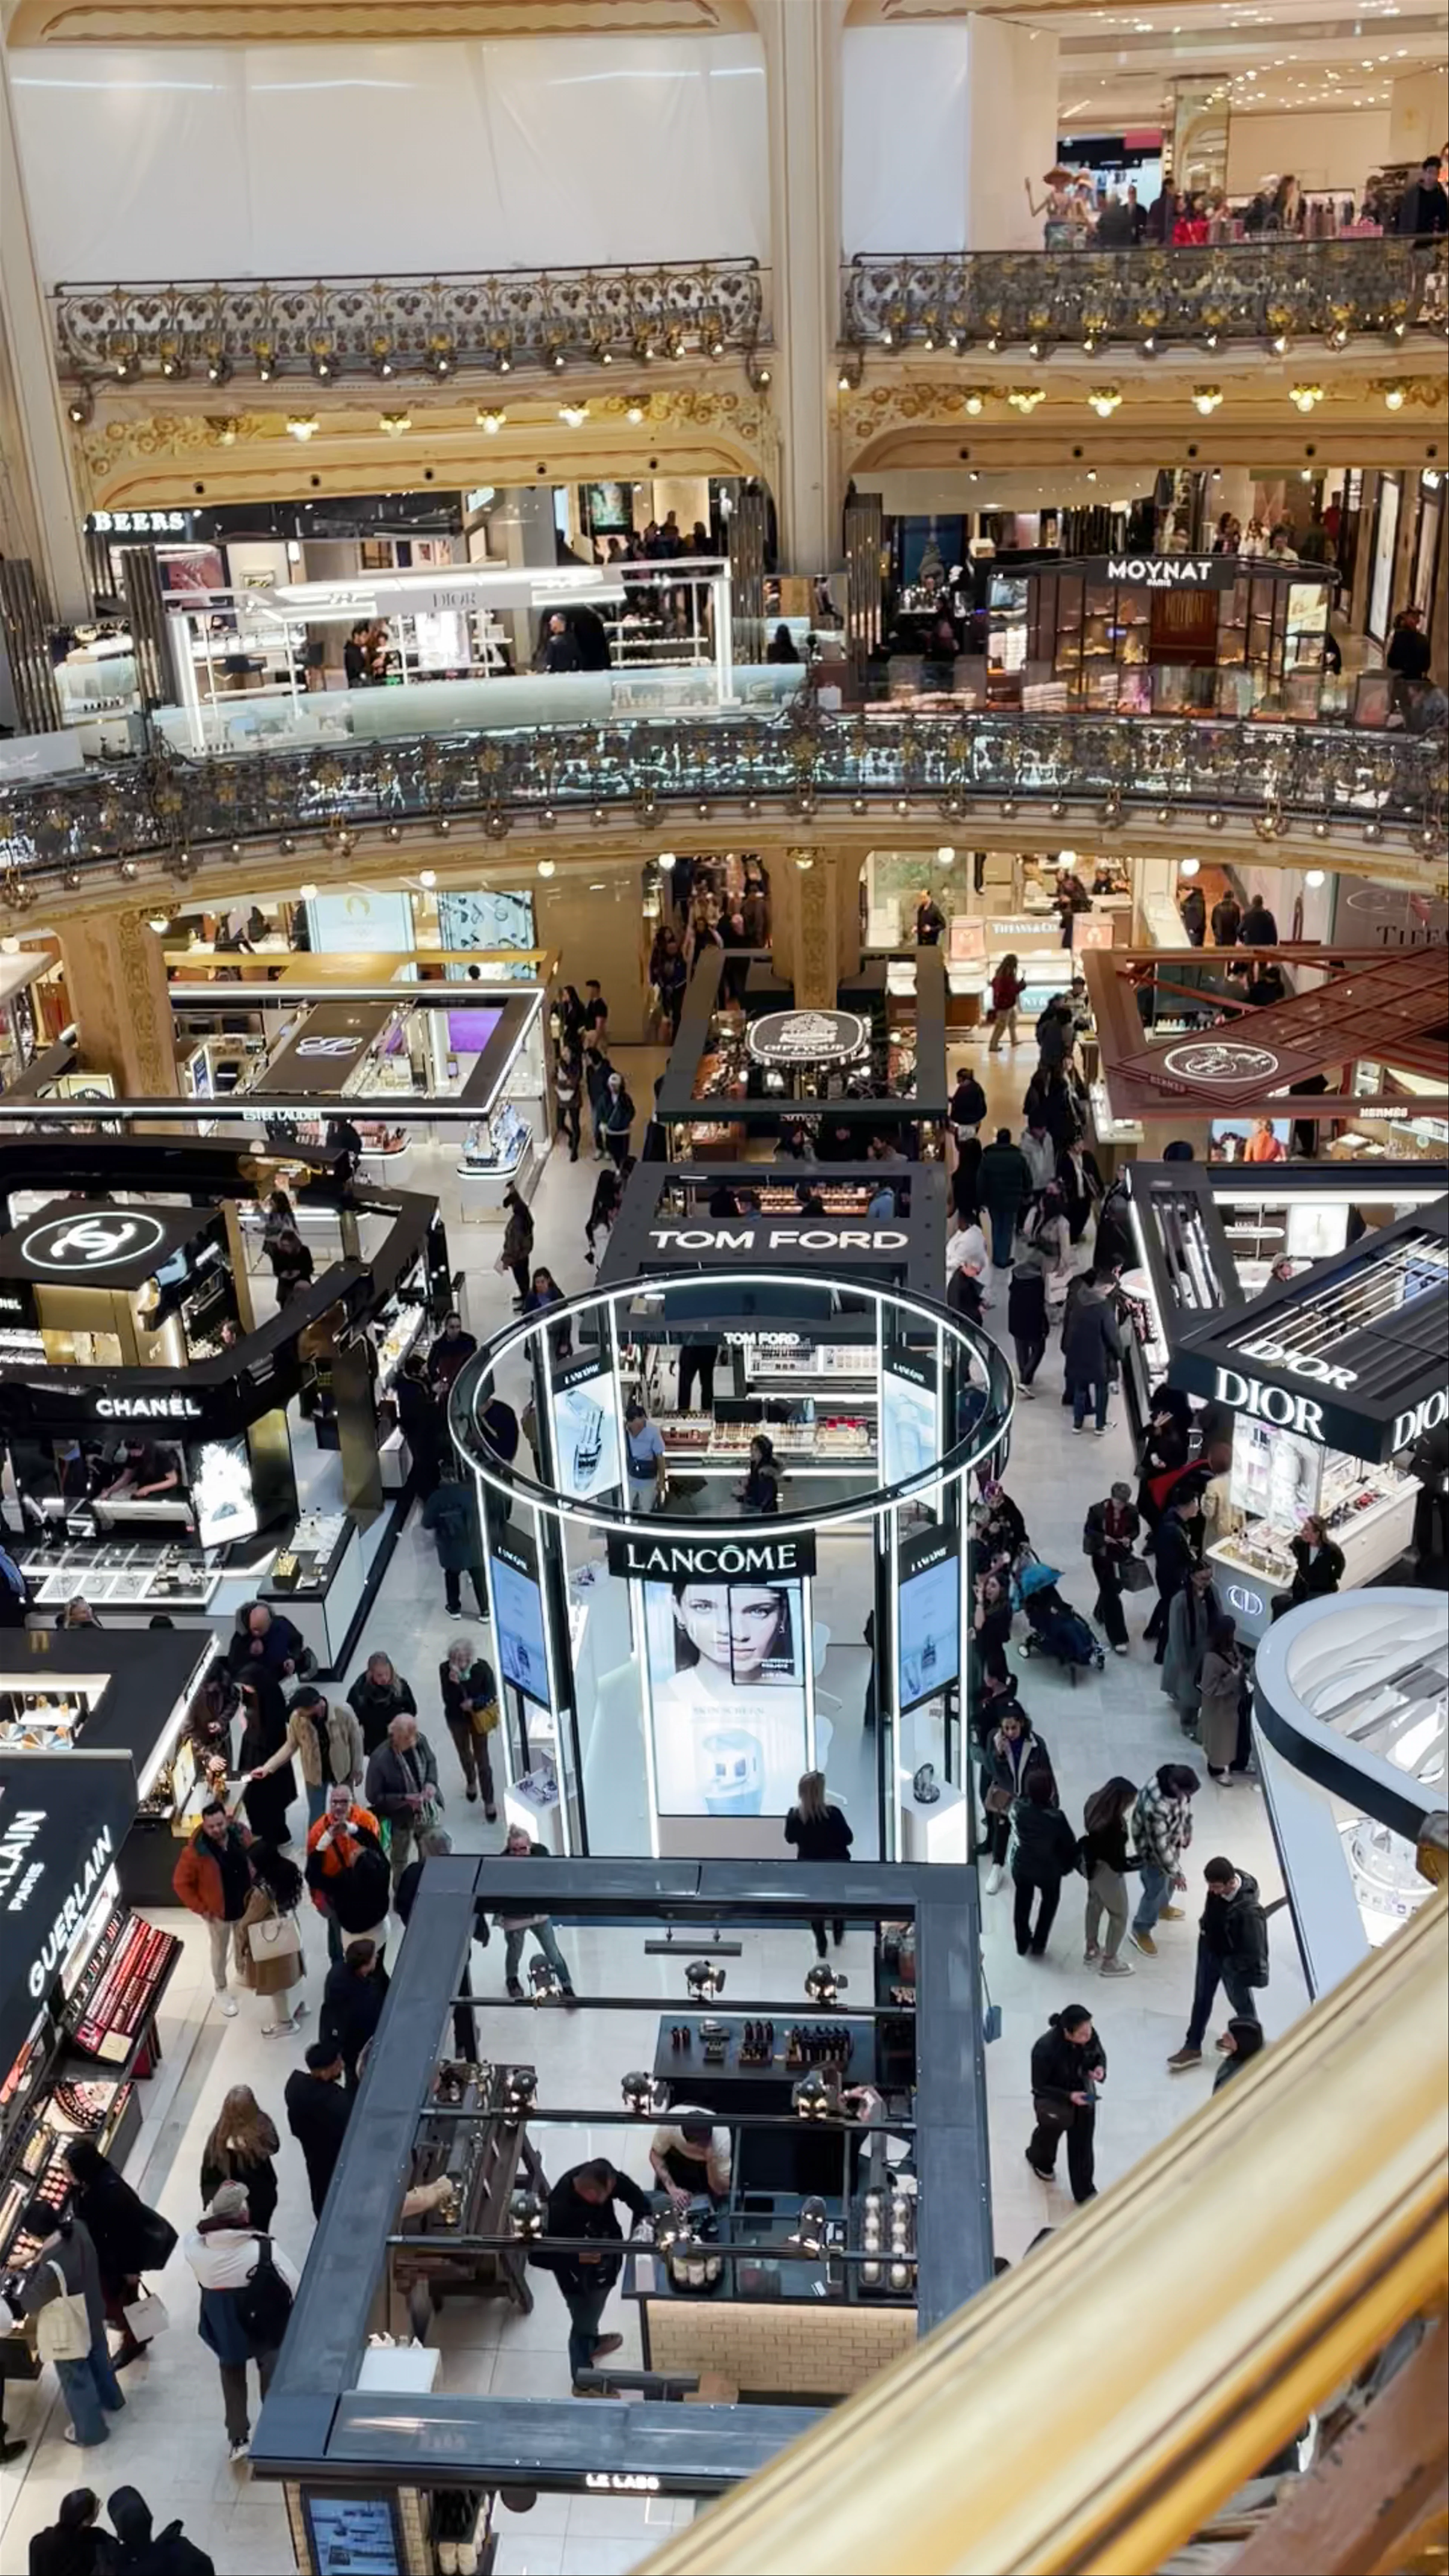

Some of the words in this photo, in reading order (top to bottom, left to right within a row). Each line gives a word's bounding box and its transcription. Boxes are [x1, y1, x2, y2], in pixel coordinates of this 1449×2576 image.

[93, 511, 185, 531] BEERS
[1108, 560, 1212, 580] MOYNAT
[433, 592, 476, 607] DIOR
[649, 1231, 755, 1249] TOM
[769, 1231, 908, 1249] FORD
[723, 1332, 756, 1345] TOM
[758, 1332, 800, 1345] FORD
[1239, 1340, 1358, 1390] DIOR
[96, 1399, 201, 1416] CHANEL
[1215, 1366, 1326, 1441] DIOR
[627, 1544, 797, 1573] LANCÔME
[8, 1862, 45, 1910] PARIS
[29, 1825, 112, 1997] GUERLAIN
[586, 2473, 610, 2487] LE
